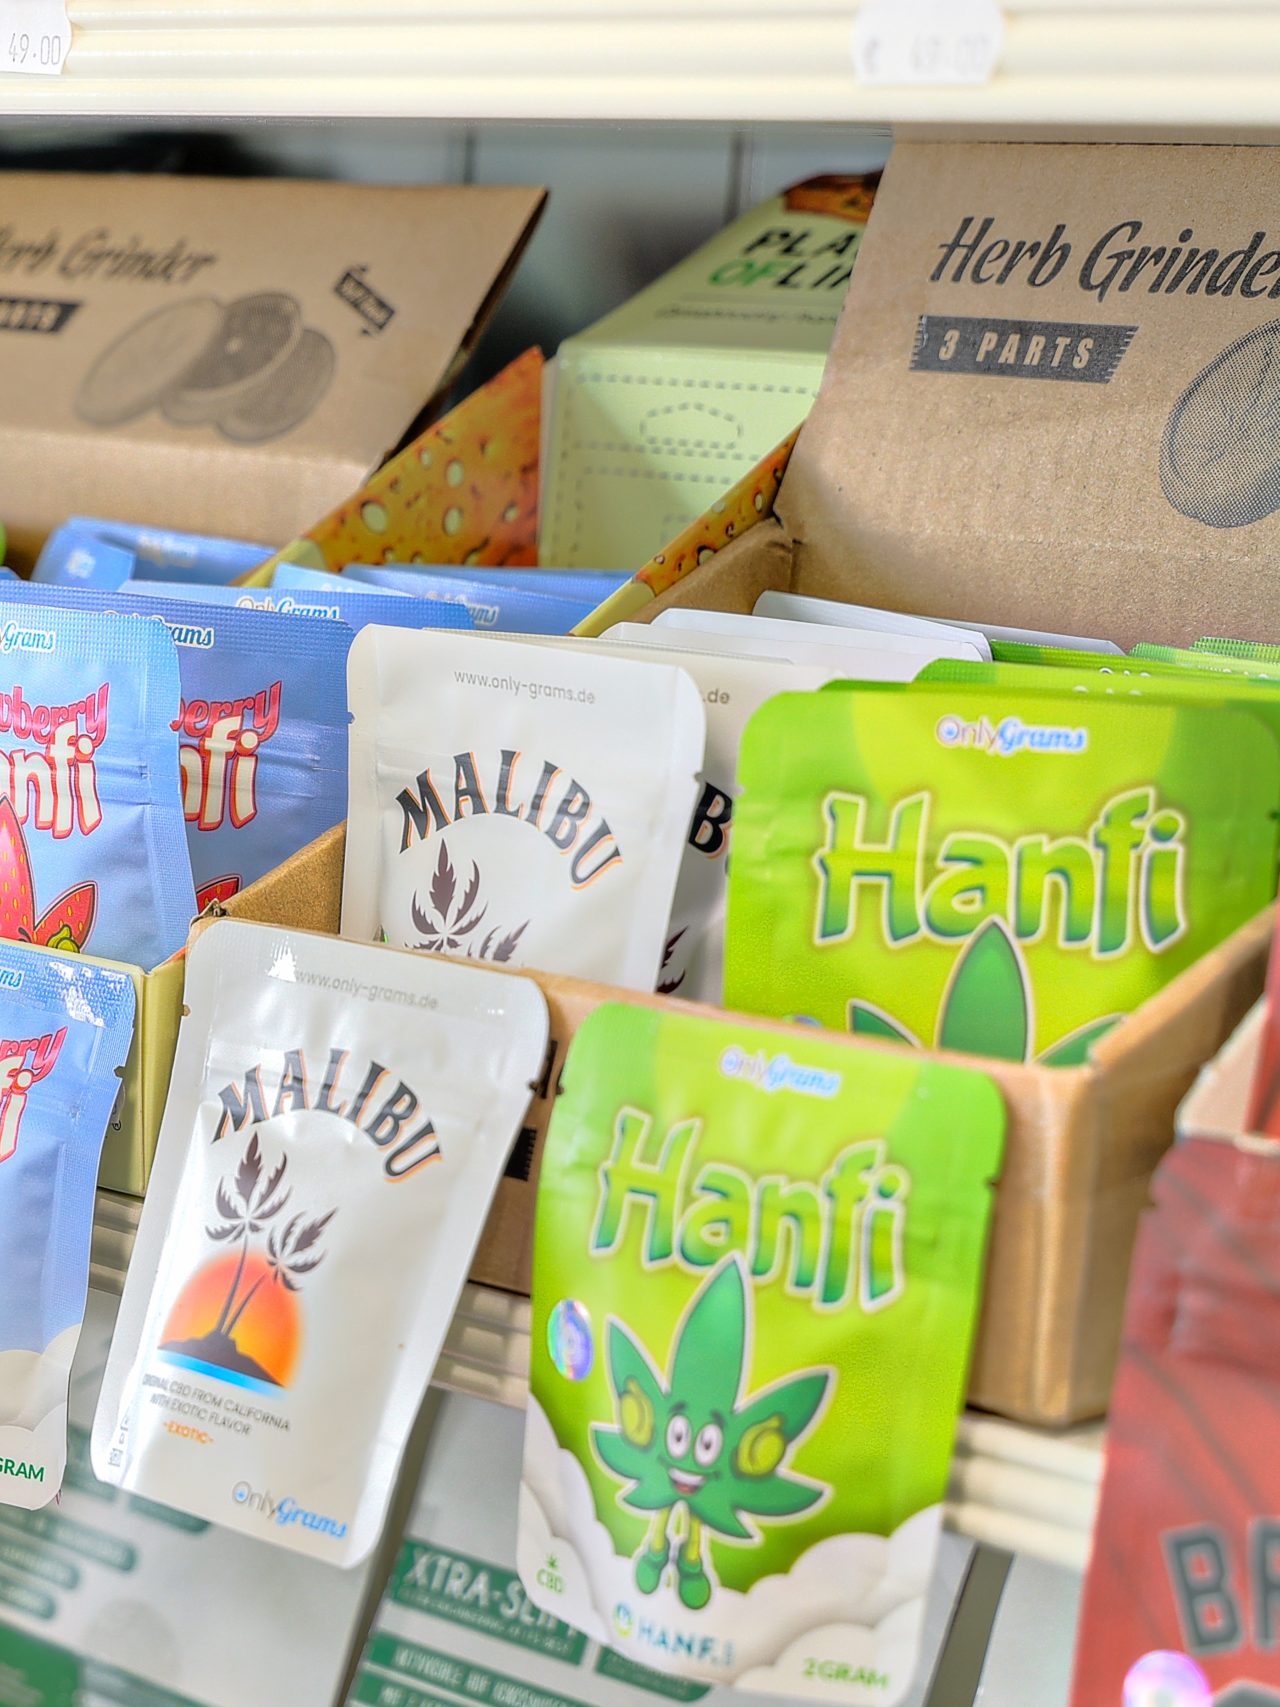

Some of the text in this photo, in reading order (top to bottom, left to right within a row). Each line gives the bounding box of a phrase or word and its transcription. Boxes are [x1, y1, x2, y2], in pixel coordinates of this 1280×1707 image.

[8, 32, 61, 65] 49.00
[929, 216, 1071, 288] Herb
[938, 328, 1096, 370] 3 PARTS
[453, 669, 596, 705] www.only-grams.de
[936, 715, 1089, 755] OnlyGrams
[394, 748, 624, 891] MALIBU
[812, 785, 1187, 959] Hanfi
[211, 1047, 444, 1184] MALIBU
[588, 1105, 911, 1314] Hanfi
[223, 1399, 291, 1432] CALIFORNIA
